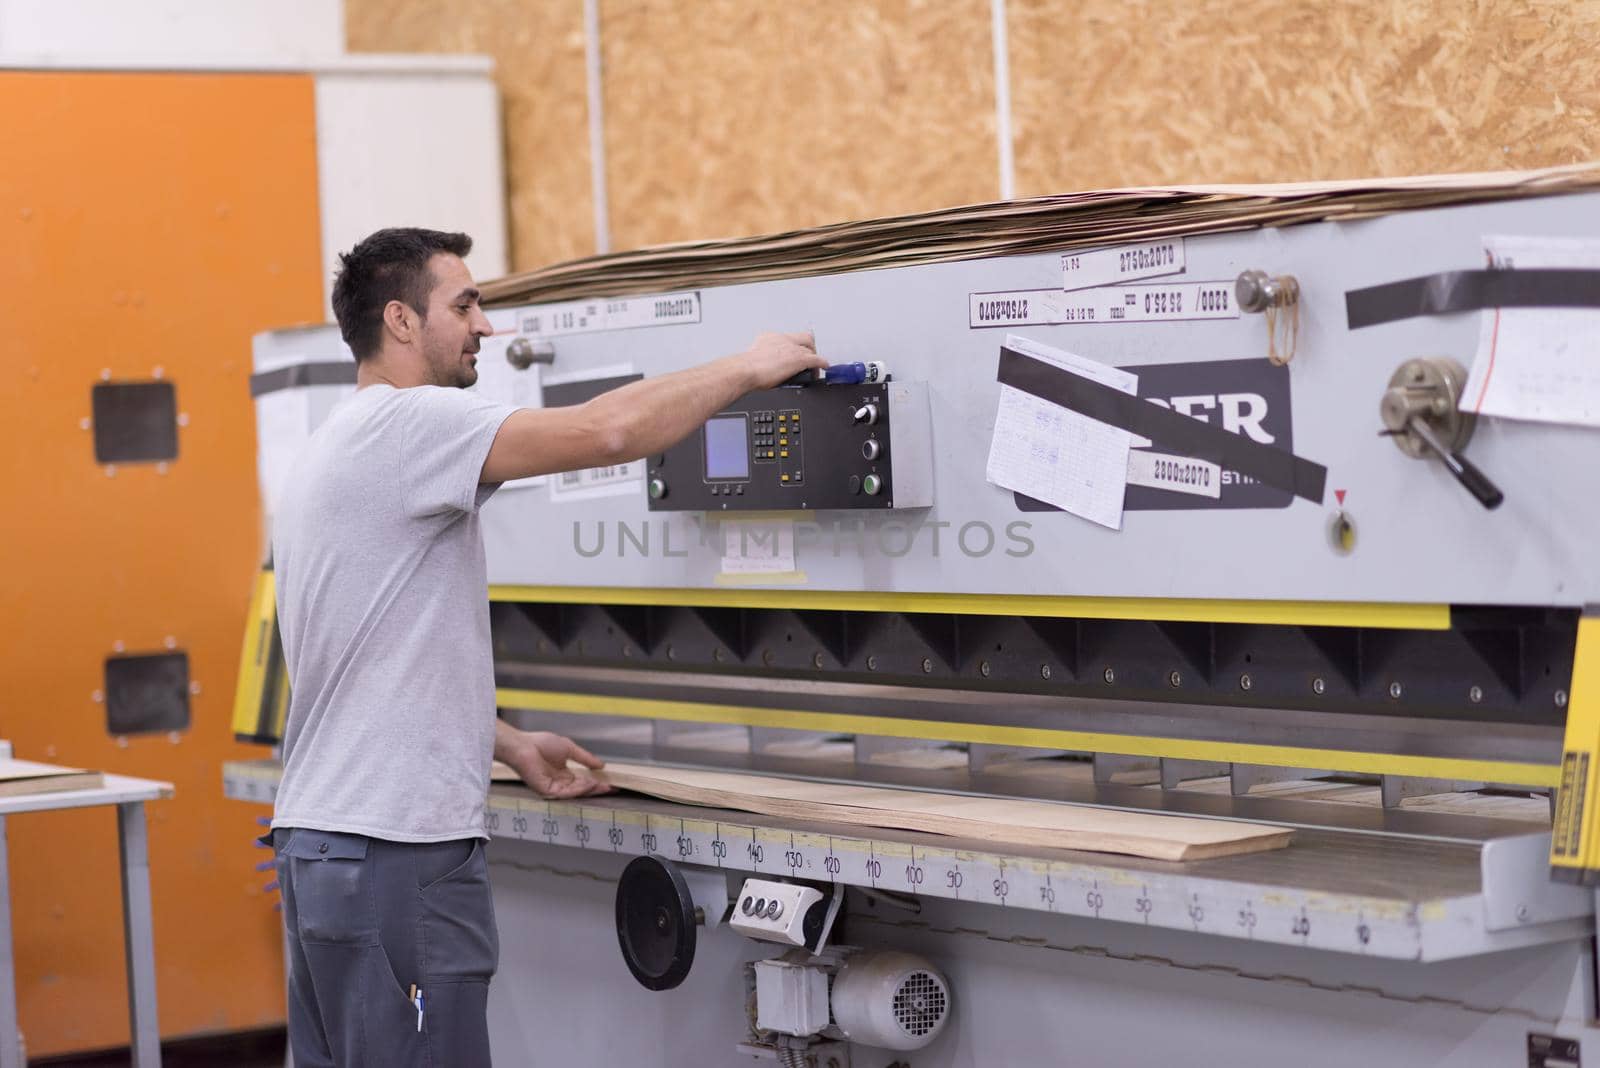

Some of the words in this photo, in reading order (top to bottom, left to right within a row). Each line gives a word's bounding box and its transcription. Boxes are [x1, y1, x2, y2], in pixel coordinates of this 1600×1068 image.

[1120, 245, 1174, 273] 2750x2070
[979, 299, 1028, 321] 2750x2070
[1154, 460, 1210, 487] 2800x2070
[641, 833, 657, 851] 170
[676, 835, 693, 857] 160
[711, 840, 727, 858] 150
[747, 843, 764, 863] 140
[785, 850, 803, 868] 130
[824, 856, 841, 874] 120
[865, 859, 881, 879] 110
[905, 865, 924, 884] 100
[946, 871, 963, 888] 90
[993, 879, 1009, 897] 80
[1039, 887, 1056, 904] 70
[1086, 891, 1103, 909] 60
